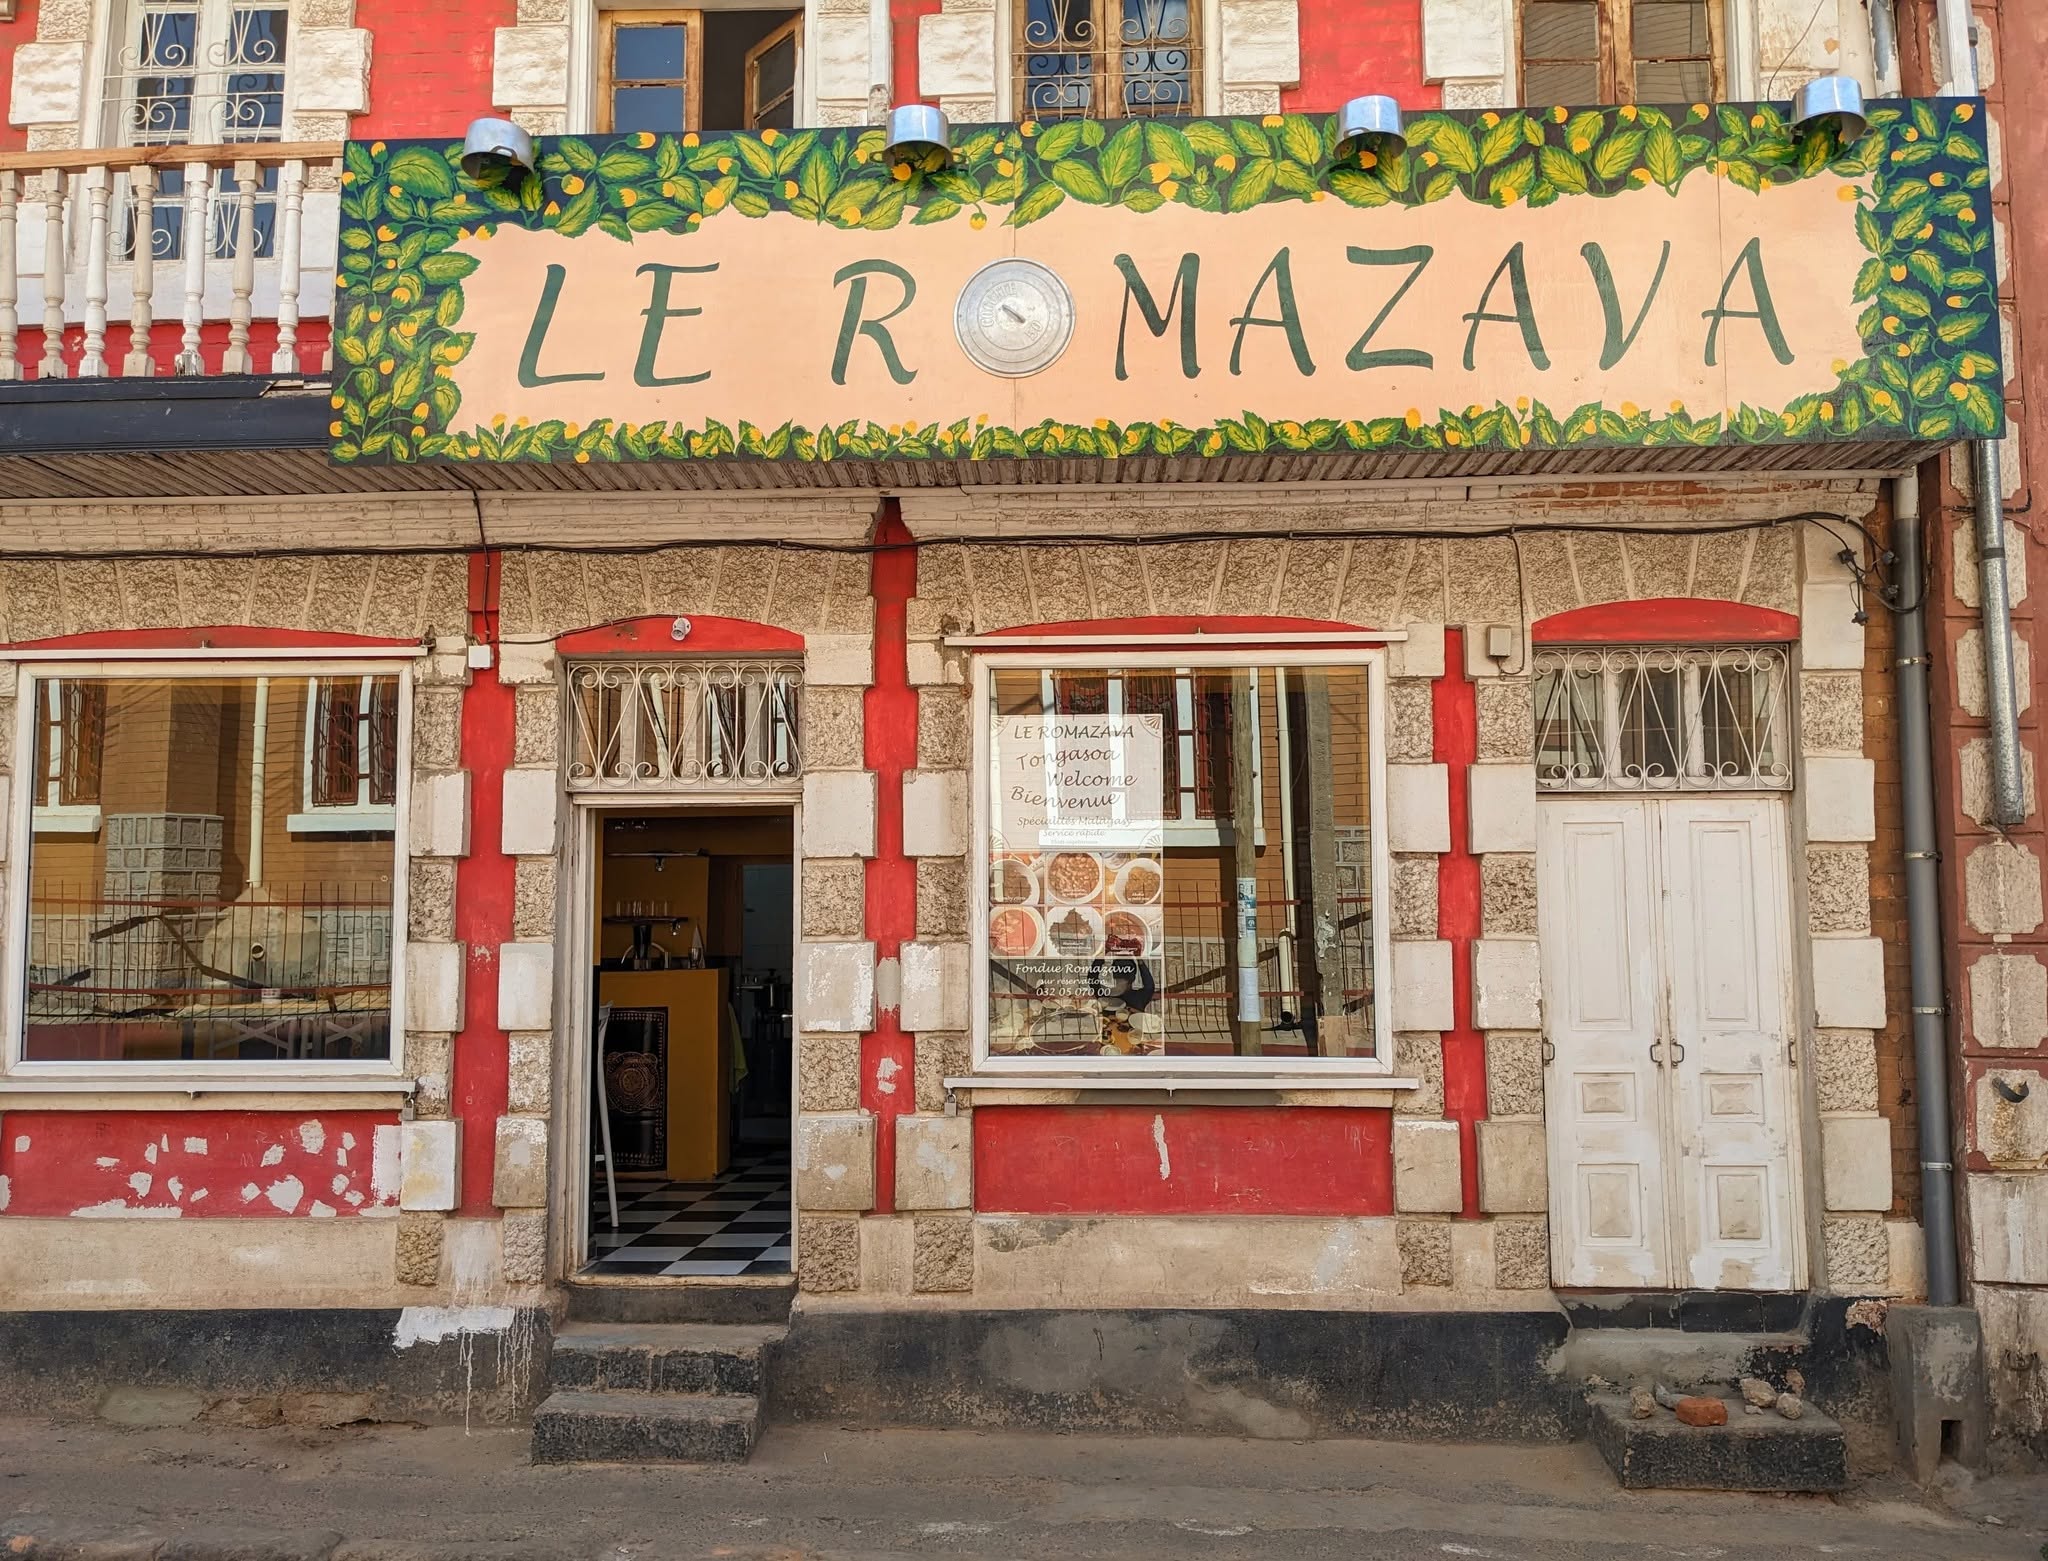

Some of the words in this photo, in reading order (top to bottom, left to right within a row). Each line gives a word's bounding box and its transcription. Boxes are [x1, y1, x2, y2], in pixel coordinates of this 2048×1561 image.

[518, 262, 720, 389] LE
[1014, 725, 1034, 739] LE
[1038, 724, 1134, 739] ROMAZAVA
[1016, 748, 1120, 770] Tongasoa
[1047, 770, 1138, 787] Welcome
[1010, 785, 1121, 809] Bienvenue
[1015, 963, 1062, 975] Fondue
[1065, 963, 1135, 976] Romazava
[1040, 978, 1056, 986] sur
[1057, 976, 1108, 987] réservation
[1036, 987, 1055, 997] 032
[1059, 987, 1071, 997] 05
[1097, 987, 1111, 997] 00
